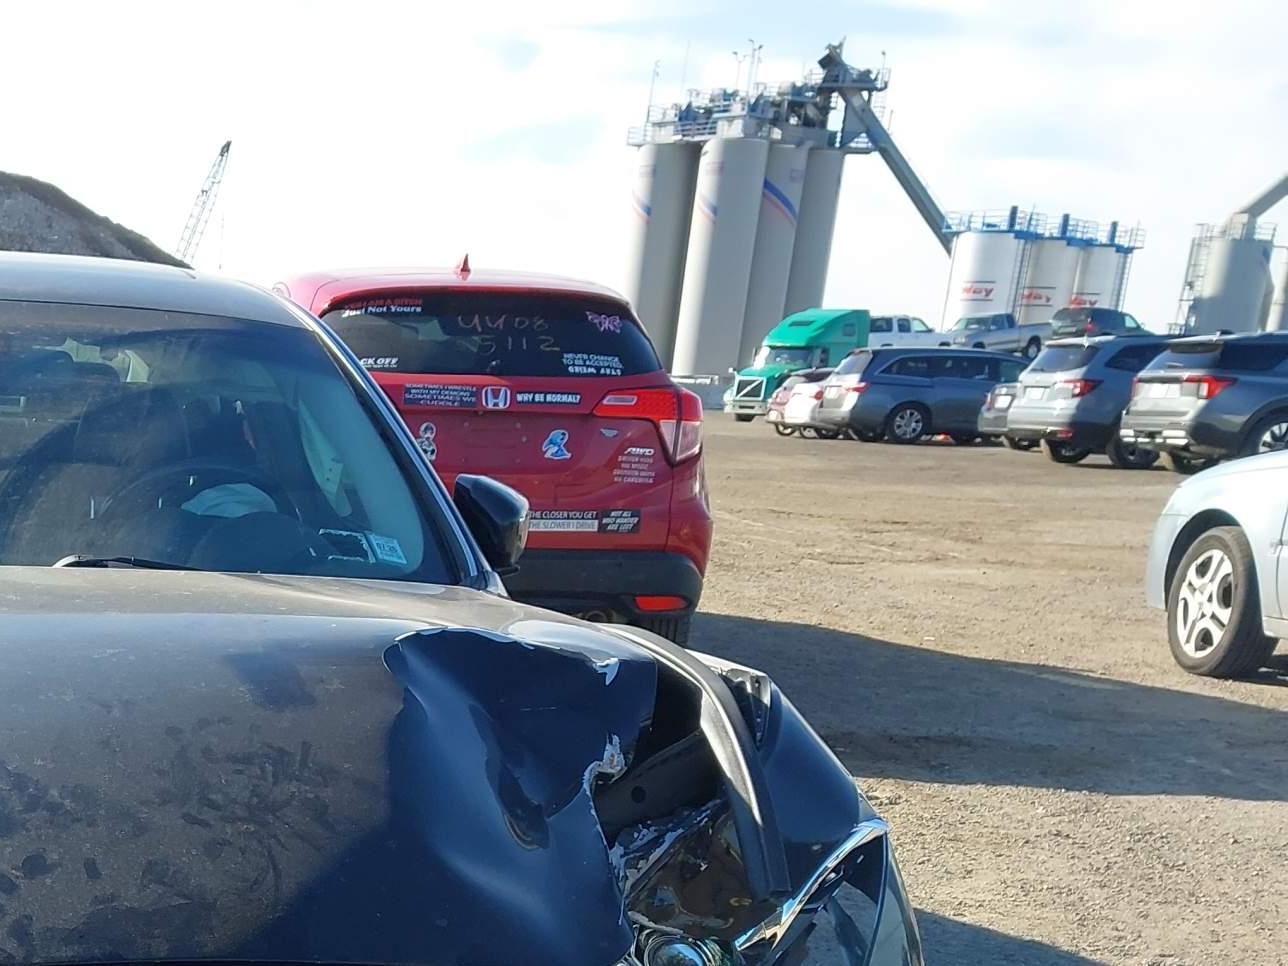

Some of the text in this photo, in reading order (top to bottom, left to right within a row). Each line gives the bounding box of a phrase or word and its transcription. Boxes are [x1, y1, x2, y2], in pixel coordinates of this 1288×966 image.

[342, 305, 422, 318] Just Not Yours
[405, 393, 461, 401] SOMETIMES
[516, 393, 533, 402] WHY
[534, 393, 545, 402] BE
[529, 510, 597, 519] THE CLOSER YOU GET
[575, 521, 596, 529] DRIVE
